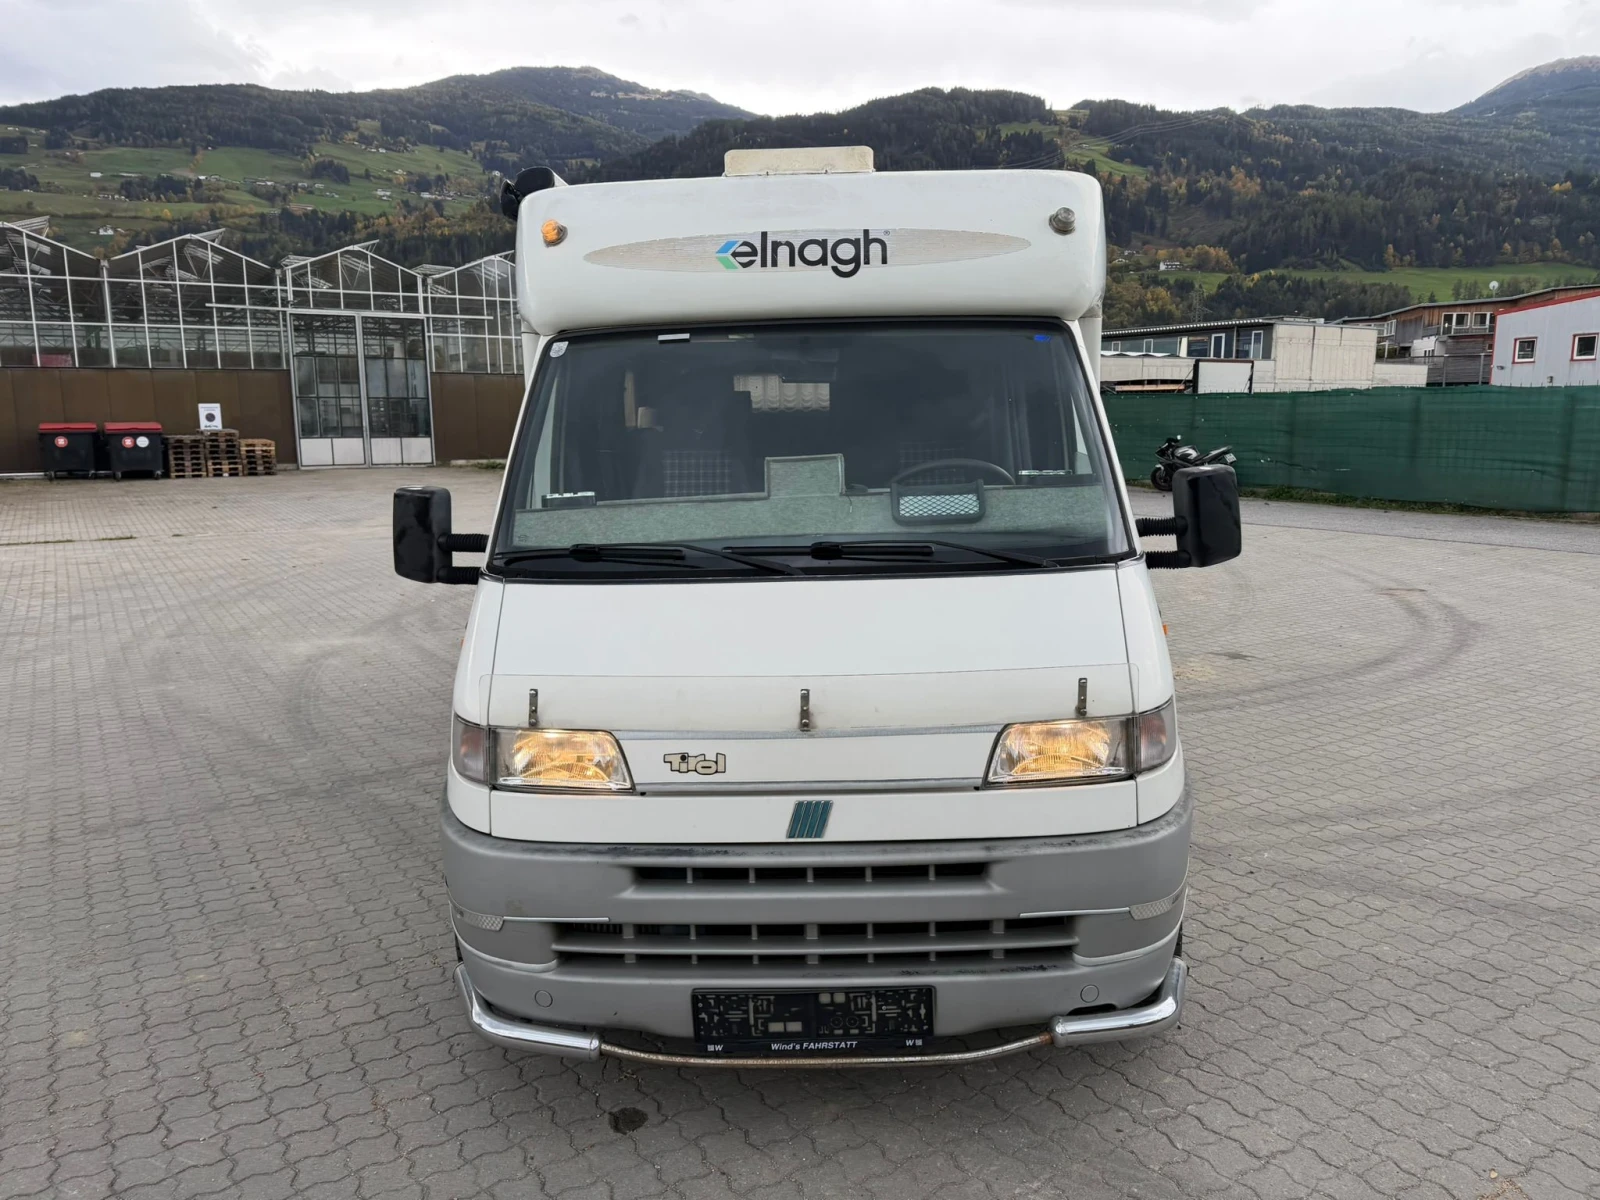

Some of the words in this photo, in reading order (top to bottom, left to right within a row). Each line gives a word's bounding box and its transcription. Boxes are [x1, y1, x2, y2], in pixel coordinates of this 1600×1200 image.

[730, 229, 888, 278] elnagh
[663, 752, 726, 775] Tirol
[802, 1041, 858, 1050] FAHRSTATT
